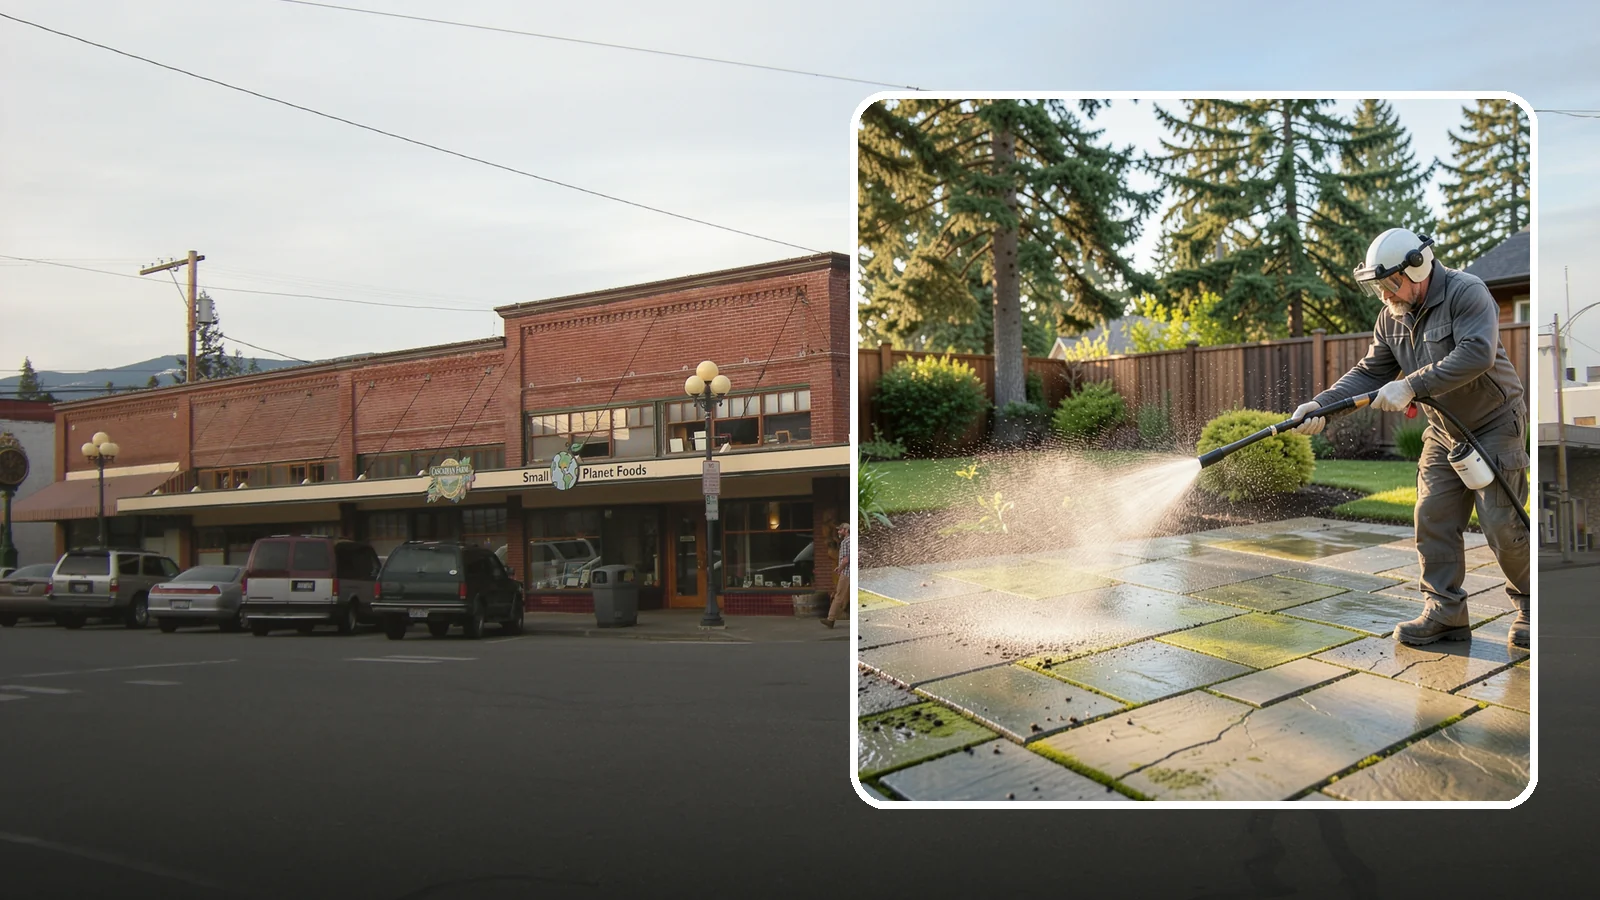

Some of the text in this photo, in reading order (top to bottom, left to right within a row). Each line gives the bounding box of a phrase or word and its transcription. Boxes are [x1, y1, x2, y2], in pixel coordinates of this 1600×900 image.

[523, 465, 647, 483] Small Planet Foods
